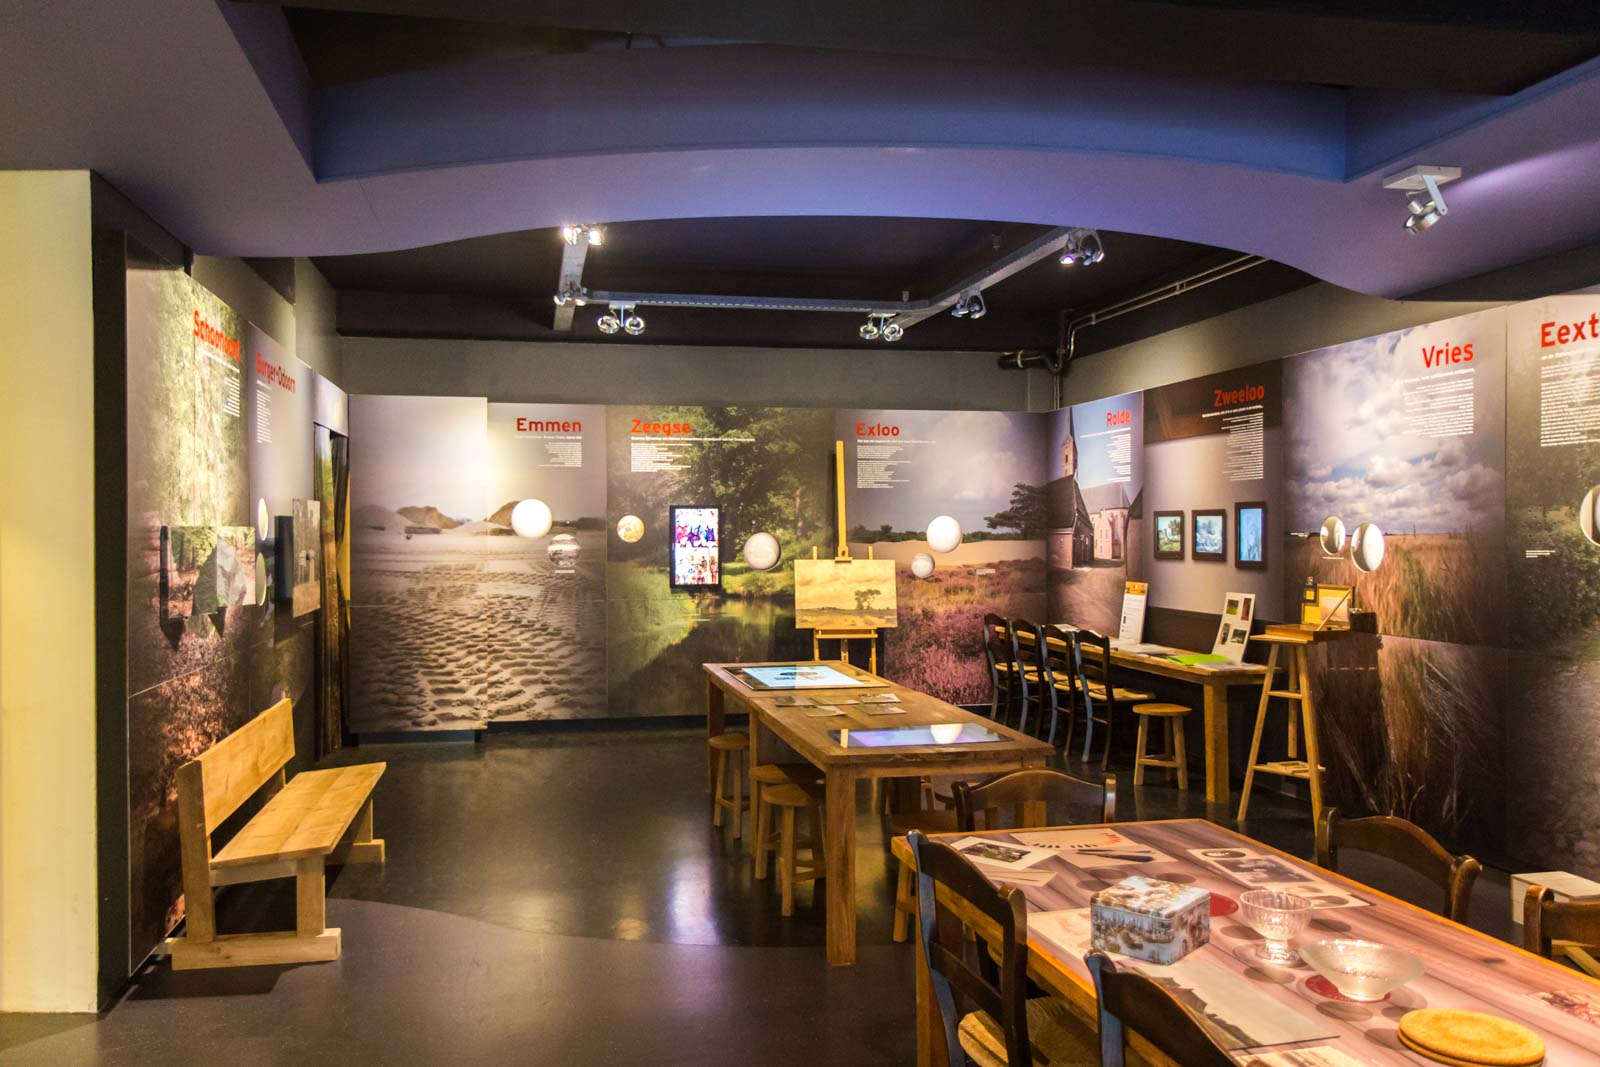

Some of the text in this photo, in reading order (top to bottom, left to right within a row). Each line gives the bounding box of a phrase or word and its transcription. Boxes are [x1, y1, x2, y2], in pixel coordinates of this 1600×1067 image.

[1541, 313, 1599, 348] Eext
[1422, 342, 1474, 368] Vries
[1213, 385, 1265, 407] Zweeloo
[517, 417, 582, 432] Emmen
[1106, 409, 1131, 426] Rolde
[631, 419, 691, 436] Zeegse
[857, 423, 900, 437] Exloo
